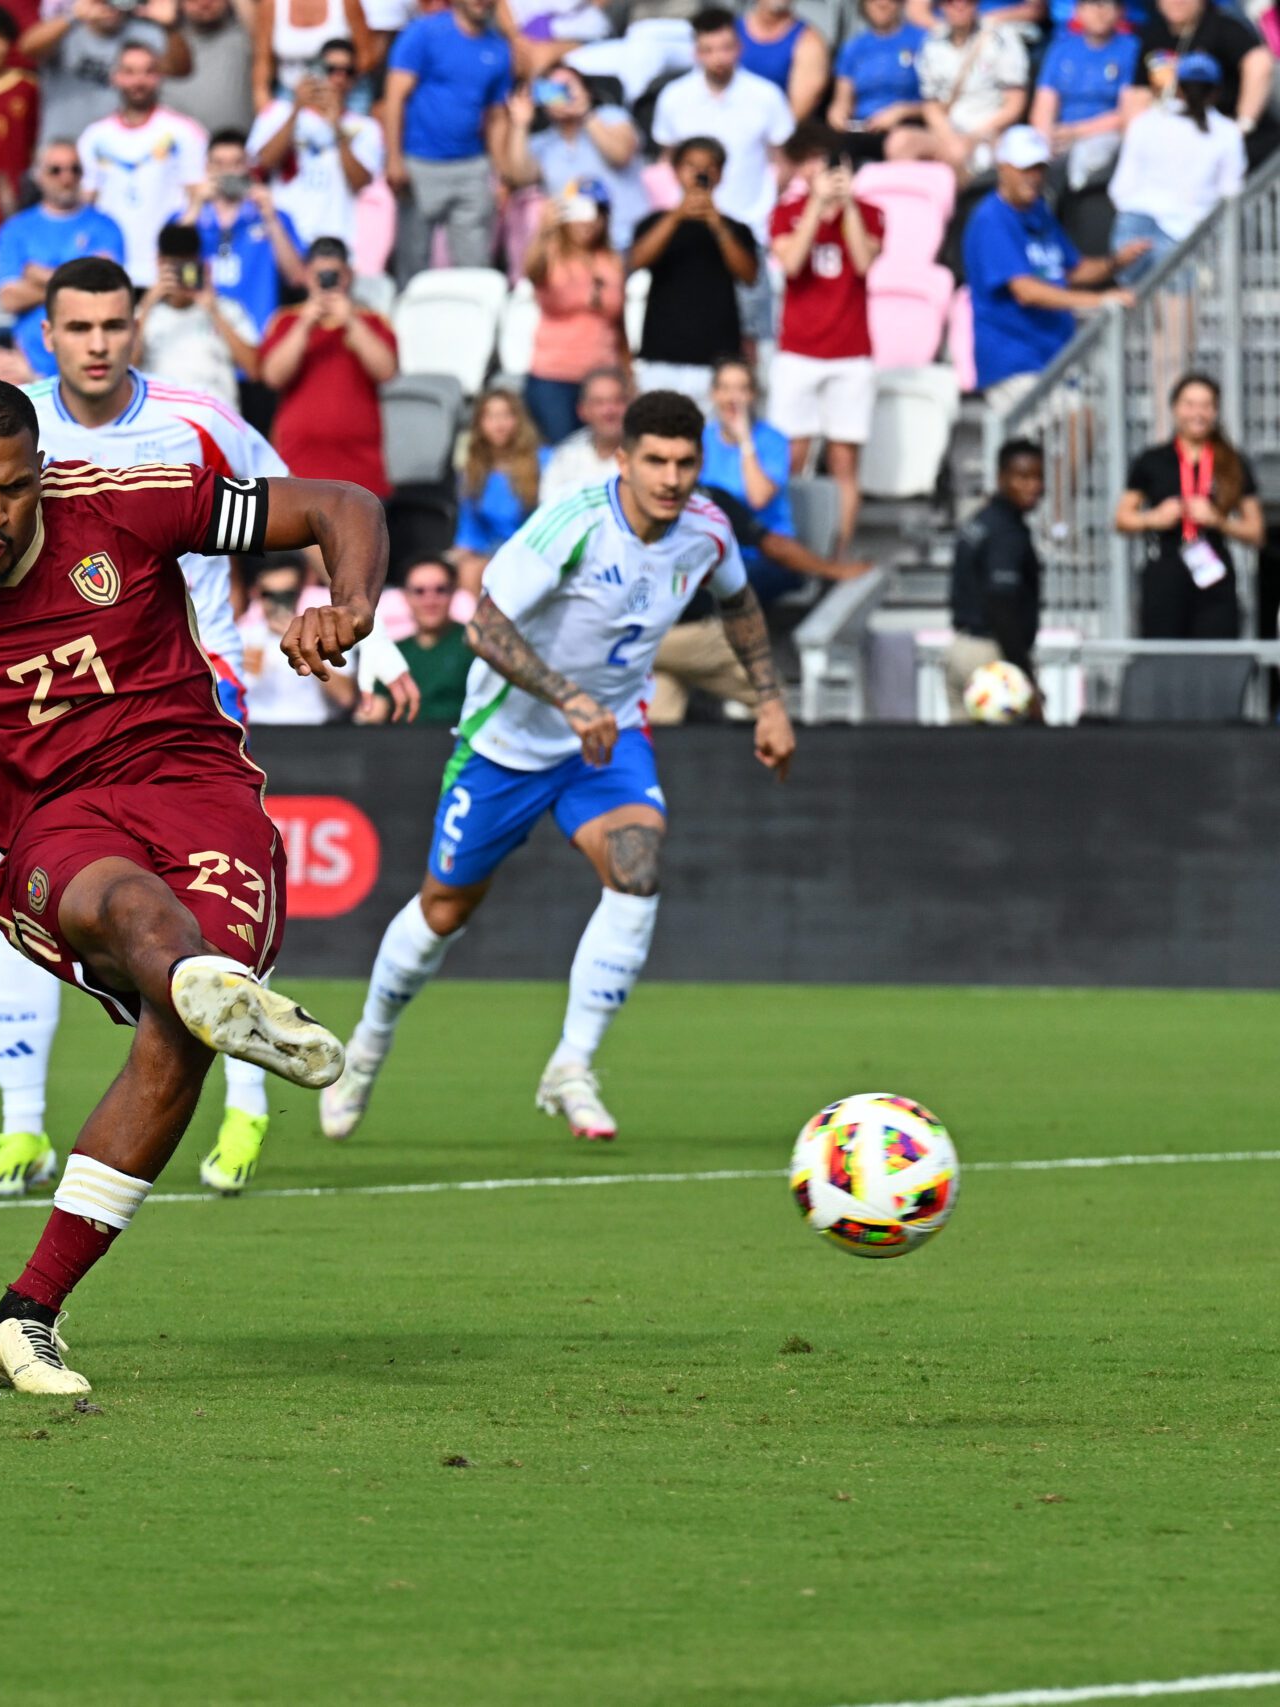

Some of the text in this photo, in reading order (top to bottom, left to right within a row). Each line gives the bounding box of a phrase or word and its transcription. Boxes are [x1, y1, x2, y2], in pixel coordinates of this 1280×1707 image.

[6, 634, 116, 726] 23
[607, 624, 643, 667] 2
[443, 786, 471, 842] 2
[186, 850, 266, 923] 23
[272, 818, 353, 887] IS
